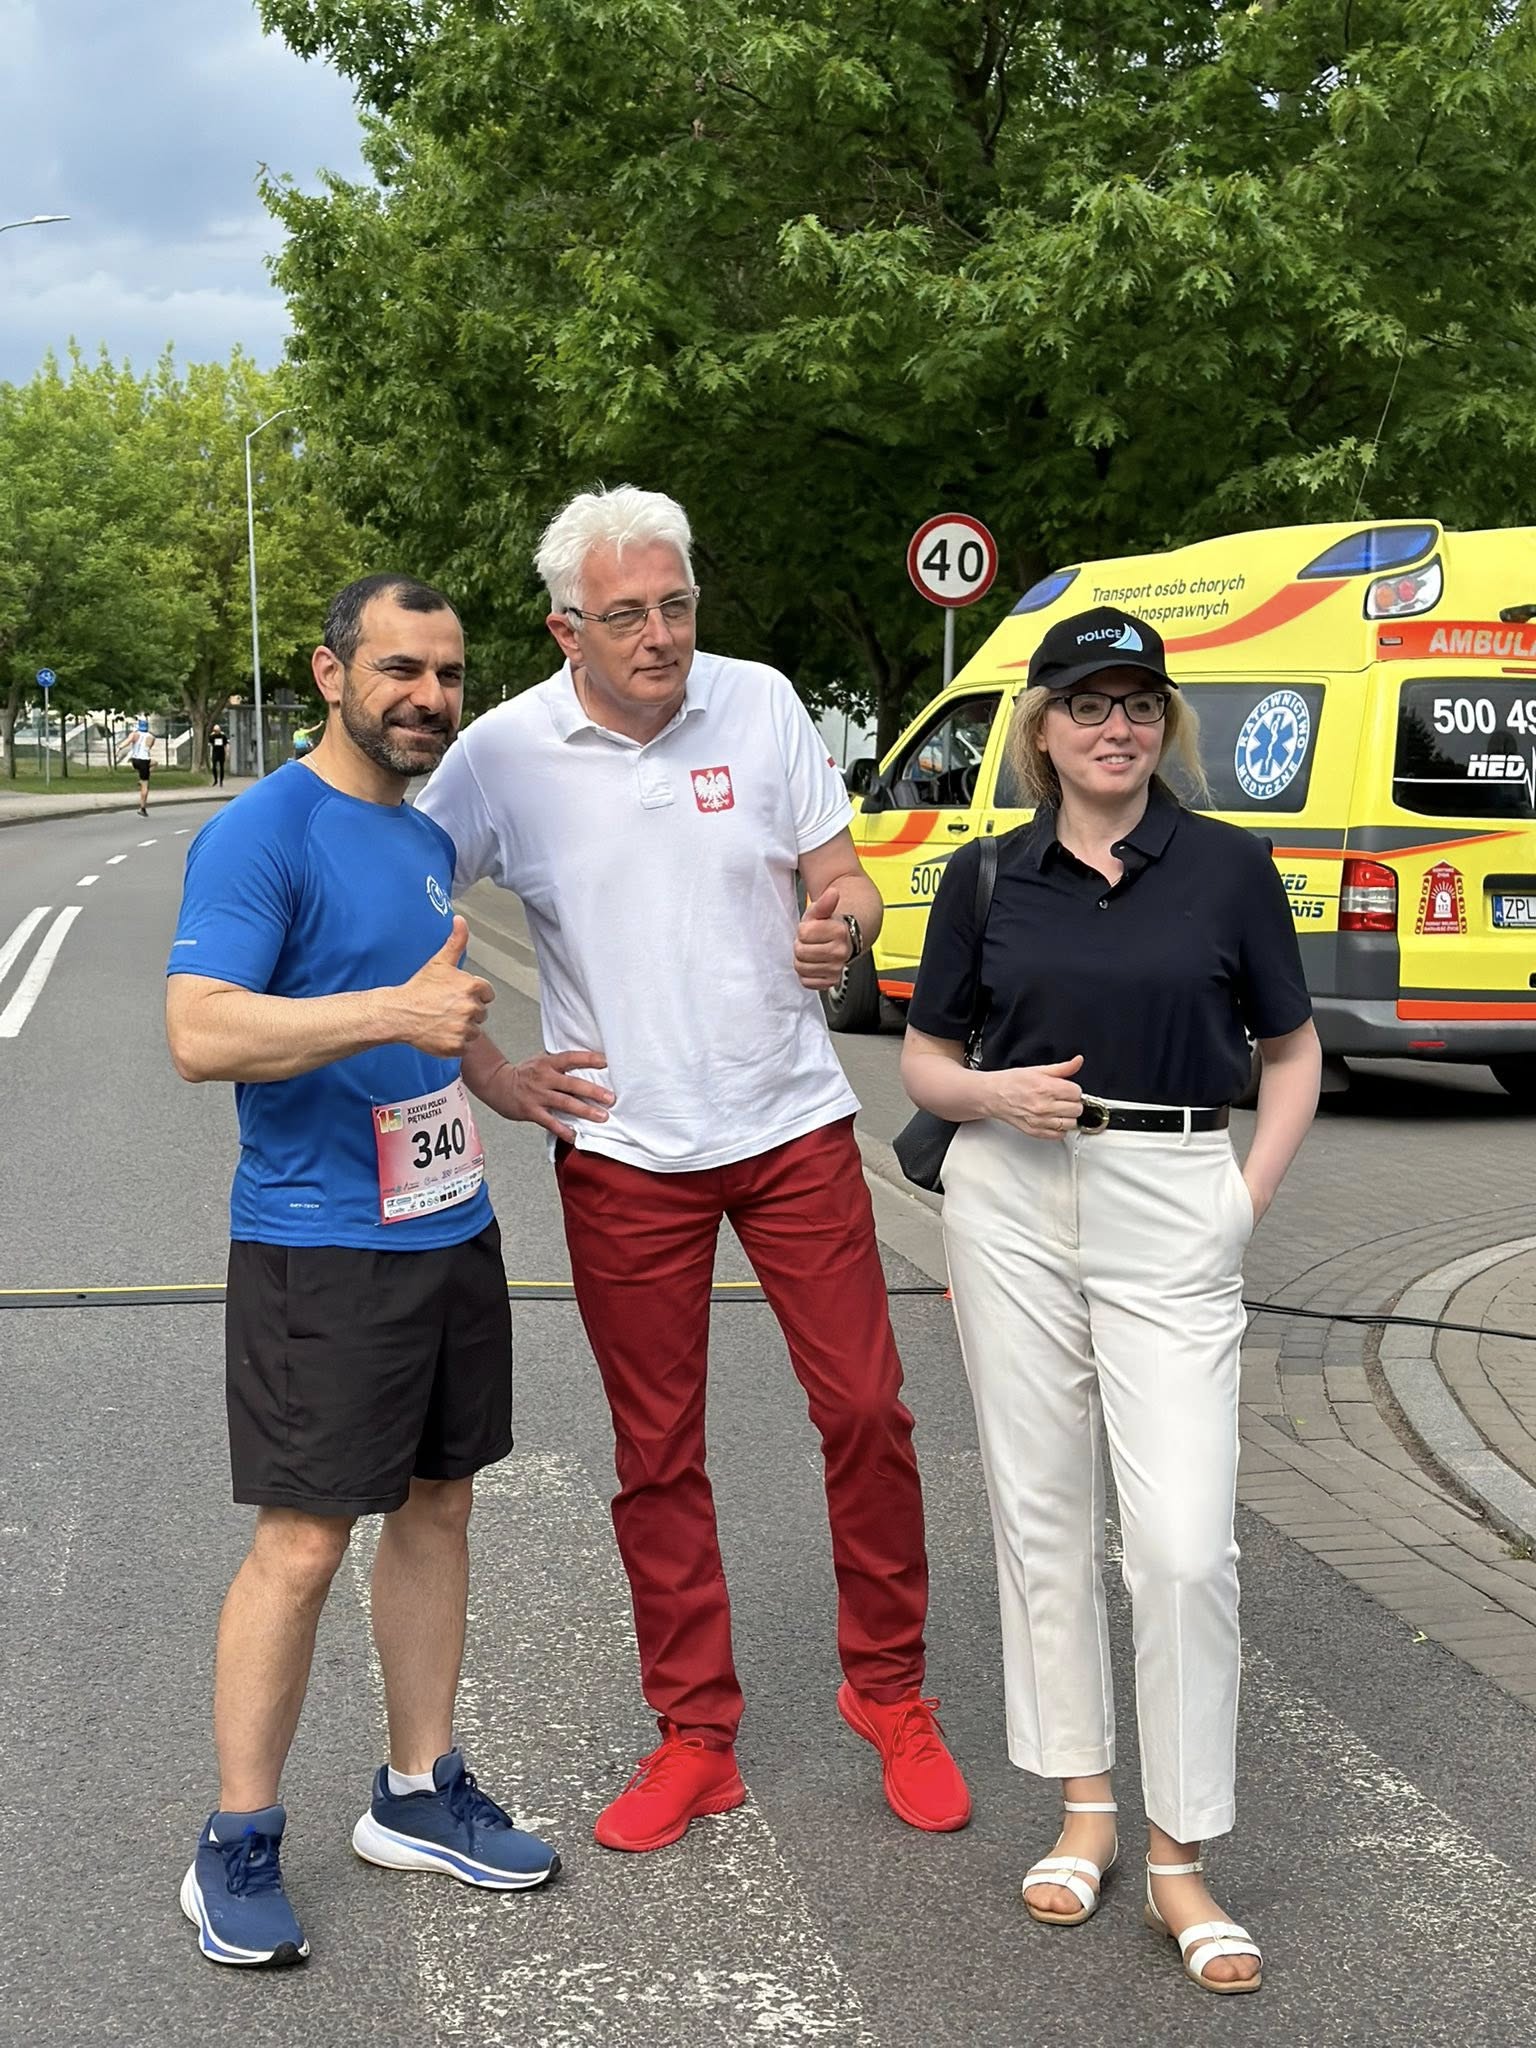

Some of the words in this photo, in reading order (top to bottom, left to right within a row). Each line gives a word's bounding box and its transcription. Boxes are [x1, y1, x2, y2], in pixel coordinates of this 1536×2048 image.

[922, 539, 984, 582] 40
[1092, 584, 1151, 603] Transport
[1154, 578, 1187, 596] osób
[1189, 573, 1246, 595] chorych
[1126, 599, 1229, 622] łnosprawnych
[1076, 628, 1122, 645] POLICE
[1428, 627, 1536, 657] AMBUL
[1238, 692, 1308, 749] RATOWNICTWO
[1432, 698, 1497, 734] 500
[1238, 760, 1298, 795] MEDYCZNE
[1467, 754, 1526, 777] HED
[911, 867, 942, 895] 500
[1503, 898, 1536, 919] ZPL
[407, 1108, 442, 1124] PIĘTNASTKA
[411, 1117, 466, 1169] 340
